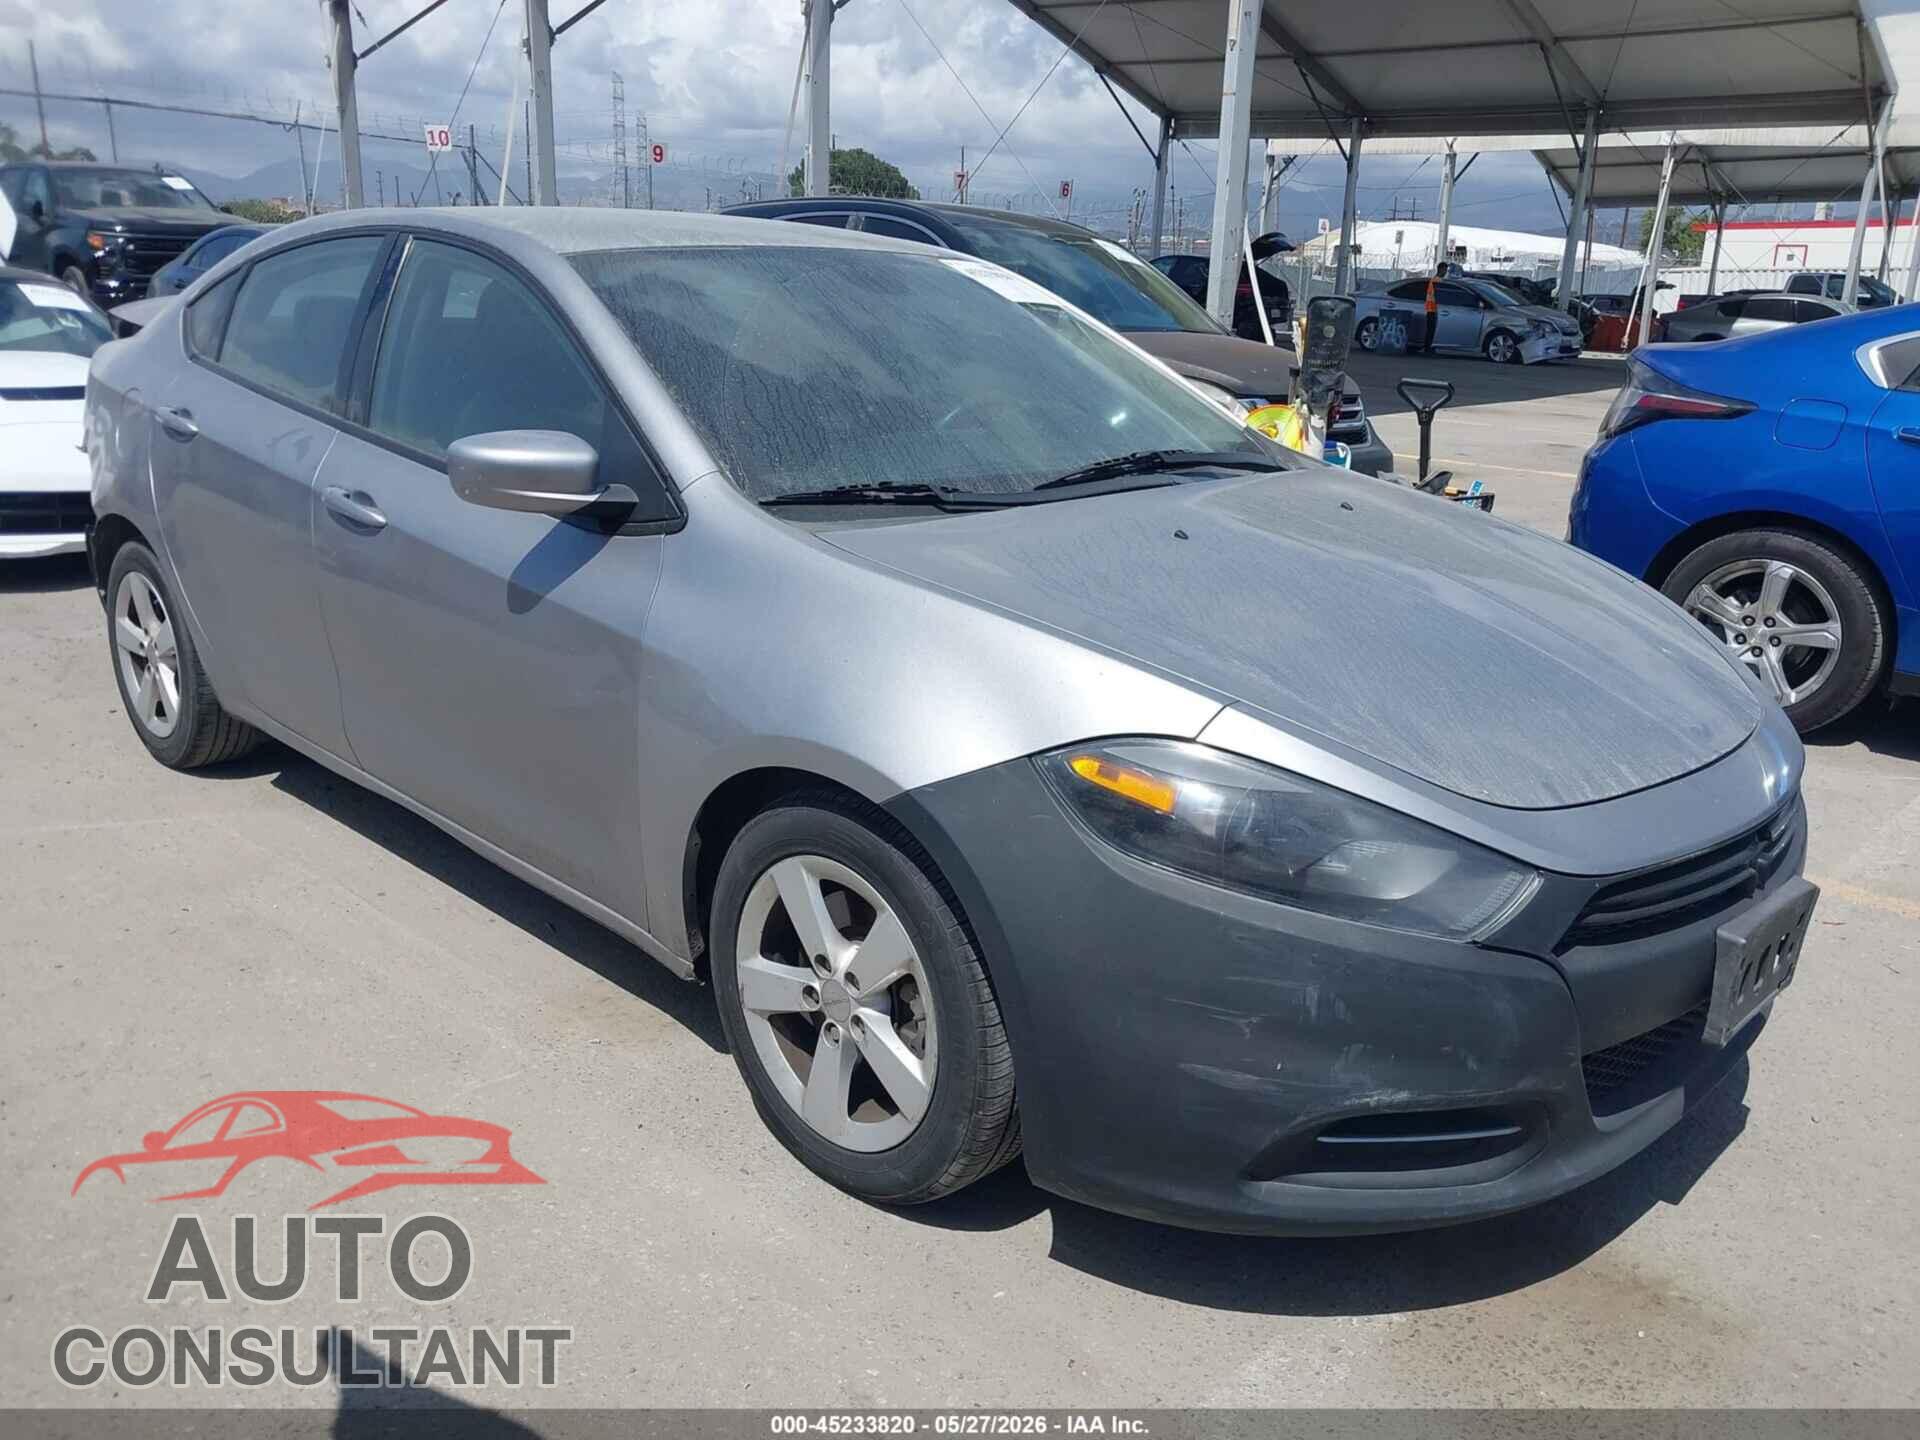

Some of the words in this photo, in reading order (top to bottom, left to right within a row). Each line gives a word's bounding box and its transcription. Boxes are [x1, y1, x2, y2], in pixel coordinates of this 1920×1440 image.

[427, 130, 449, 147] 10
[653, 145, 664, 163] 9
[956, 174, 965, 190] 7
[1062, 183, 1070, 197] 6
